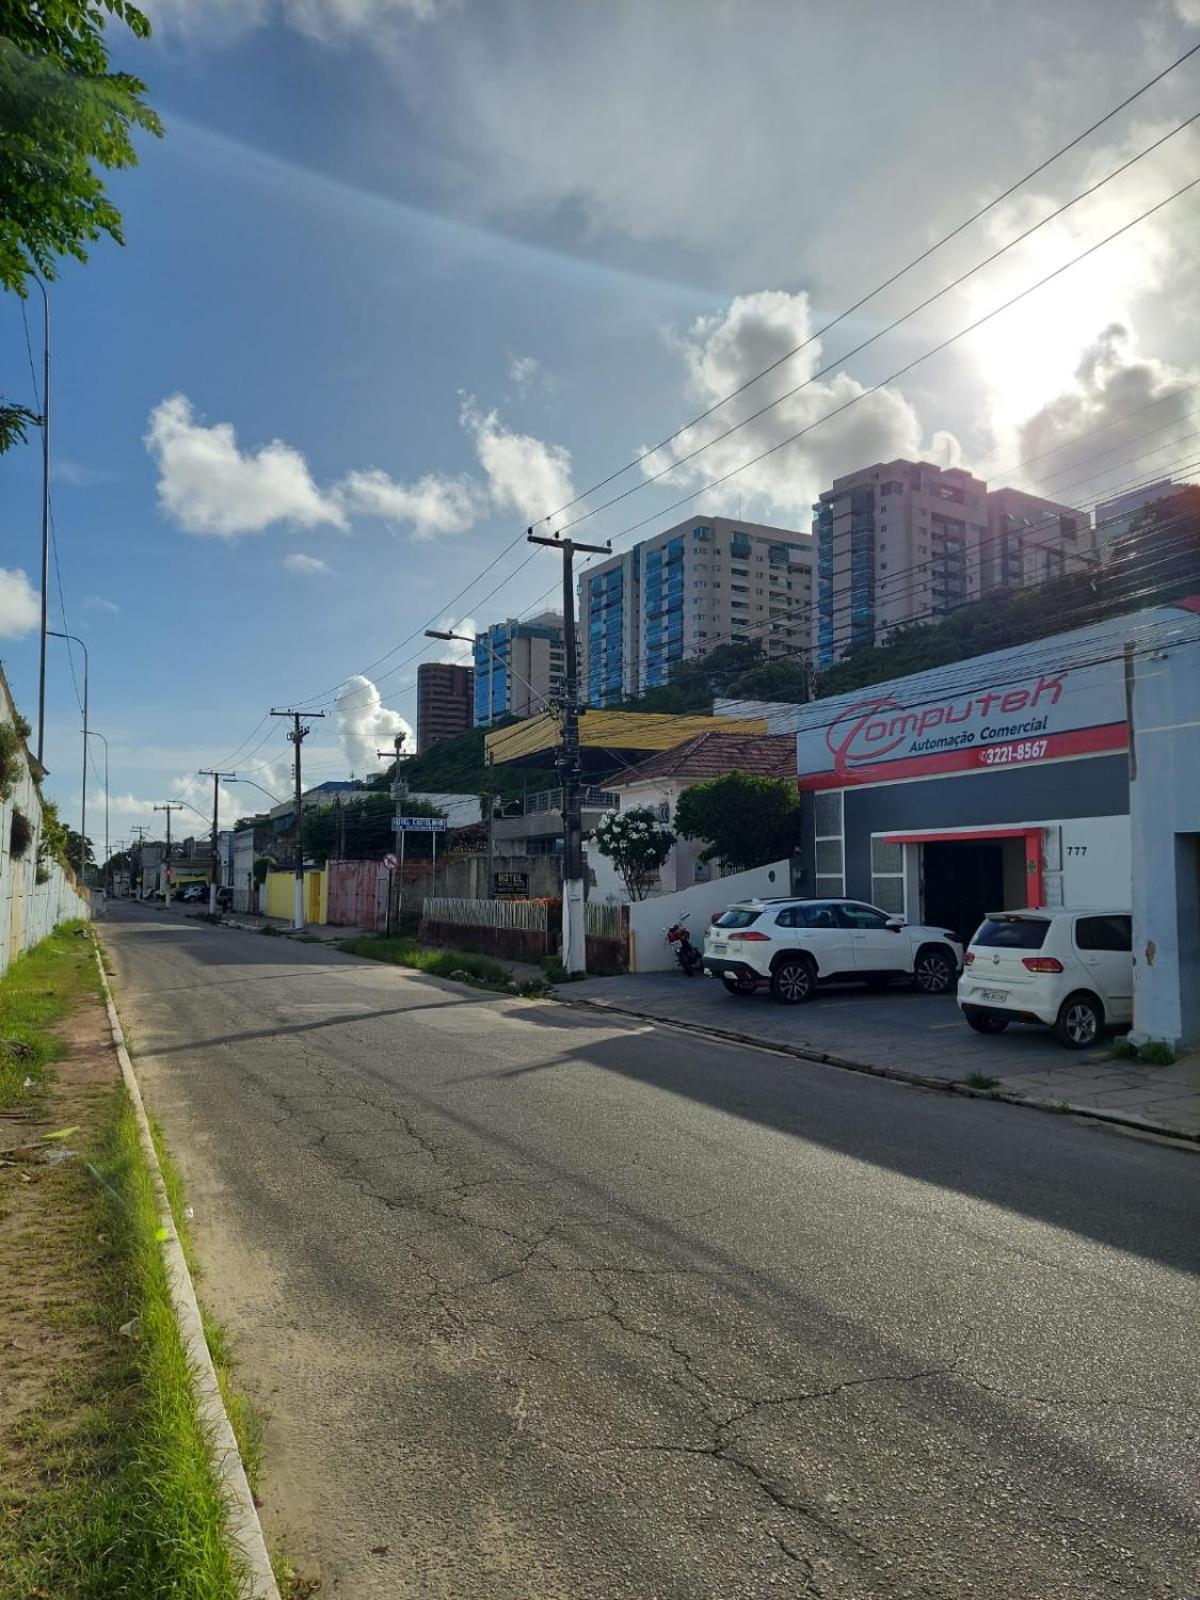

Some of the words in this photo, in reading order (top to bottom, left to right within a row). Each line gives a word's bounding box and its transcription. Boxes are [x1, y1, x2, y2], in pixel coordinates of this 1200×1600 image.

[909, 730, 975, 753] Automação
[979, 714, 1049, 740] Comercial
[985, 740, 1049, 764] 3221-8567
[1066, 846, 1087, 857] 777
